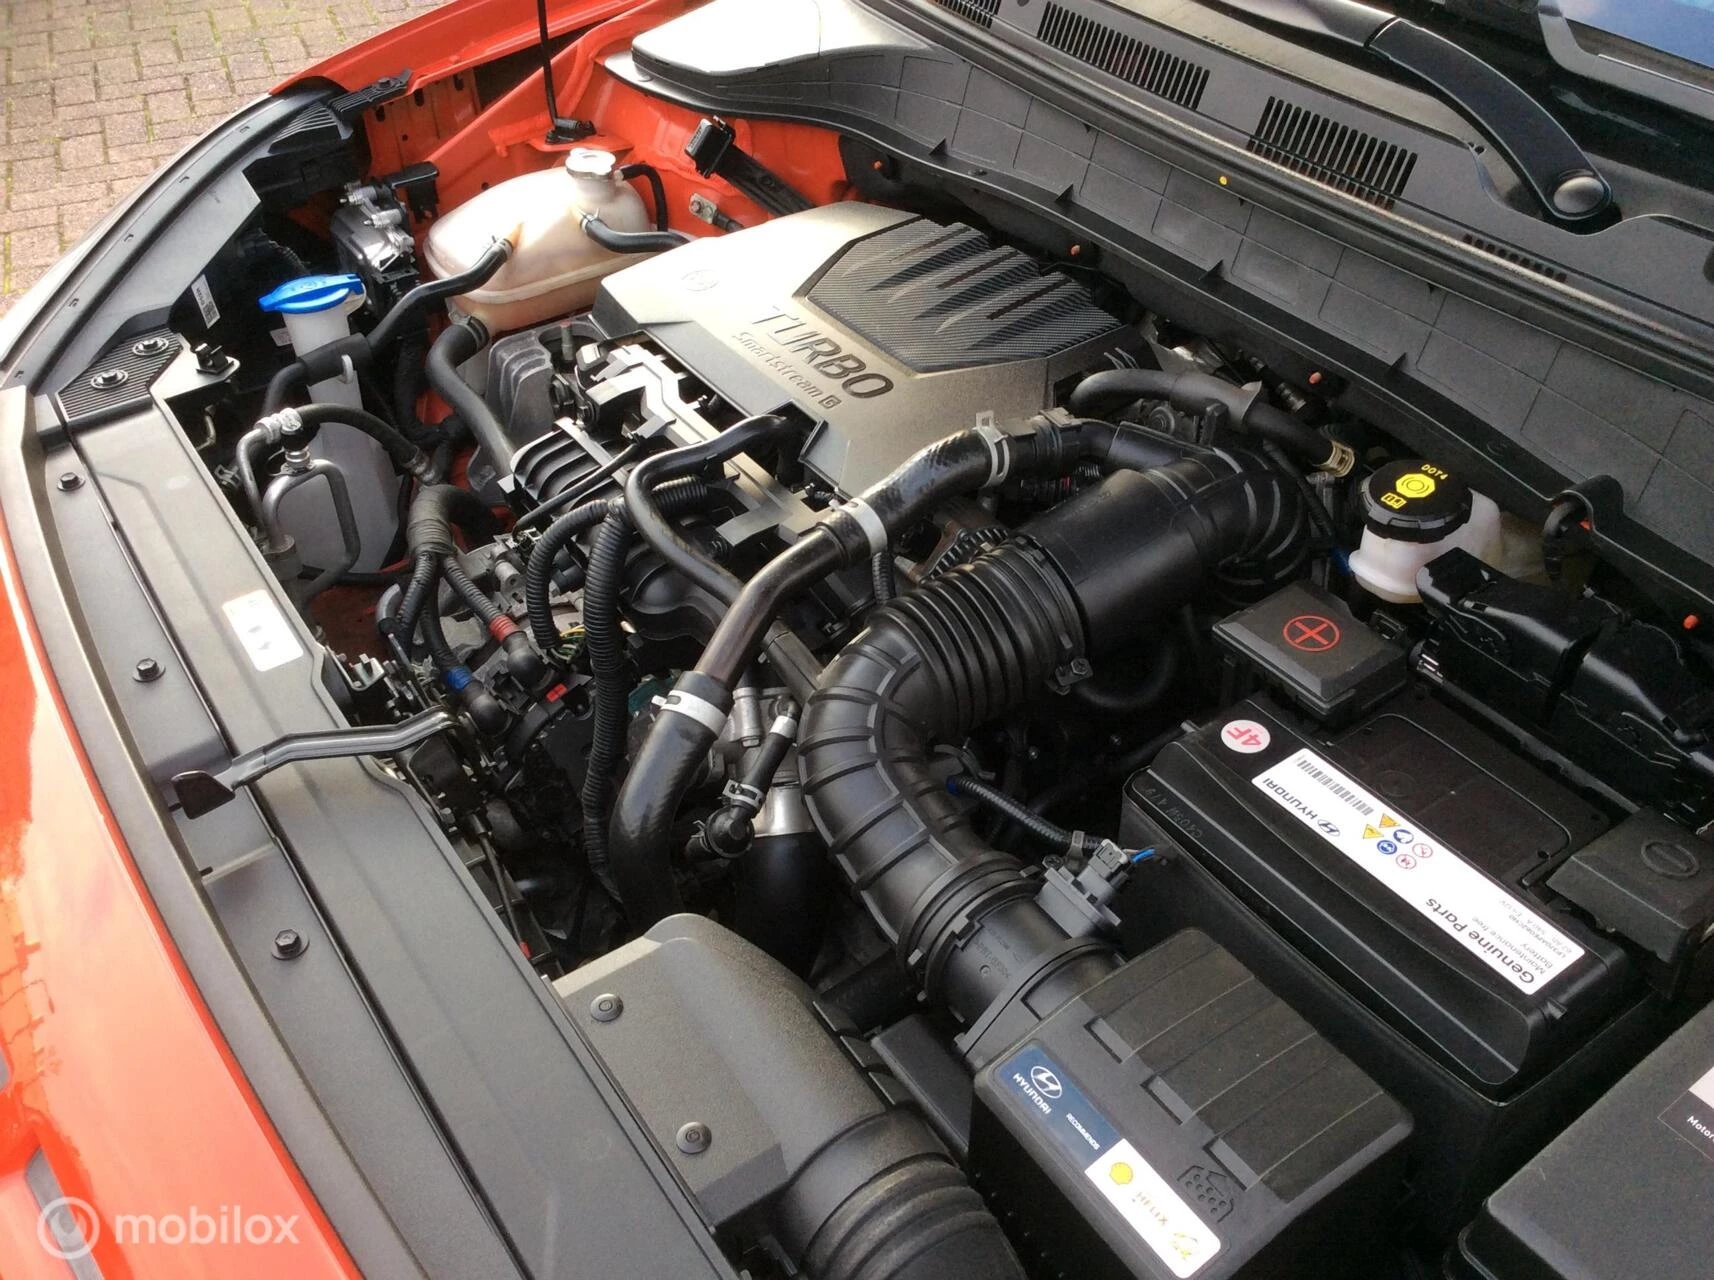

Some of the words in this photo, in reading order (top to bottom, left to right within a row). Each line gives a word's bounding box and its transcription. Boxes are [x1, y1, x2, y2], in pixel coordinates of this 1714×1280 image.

[732, 332, 823, 398] Smartstream
[752, 305, 894, 399] TURBO
[1227, 726, 1262, 747] 4F
[1262, 777, 1318, 820] HYUNDAI
[1426, 898, 1468, 932] Parts
[1468, 930, 1535, 984] Genuine
[1488, 929, 1546, 975] Maintenance
[1521, 943, 1553, 969] Battery
[1012, 1072, 1052, 1115] HYUNDAI
[1066, 1113, 1100, 1150] RECOMMENDS
